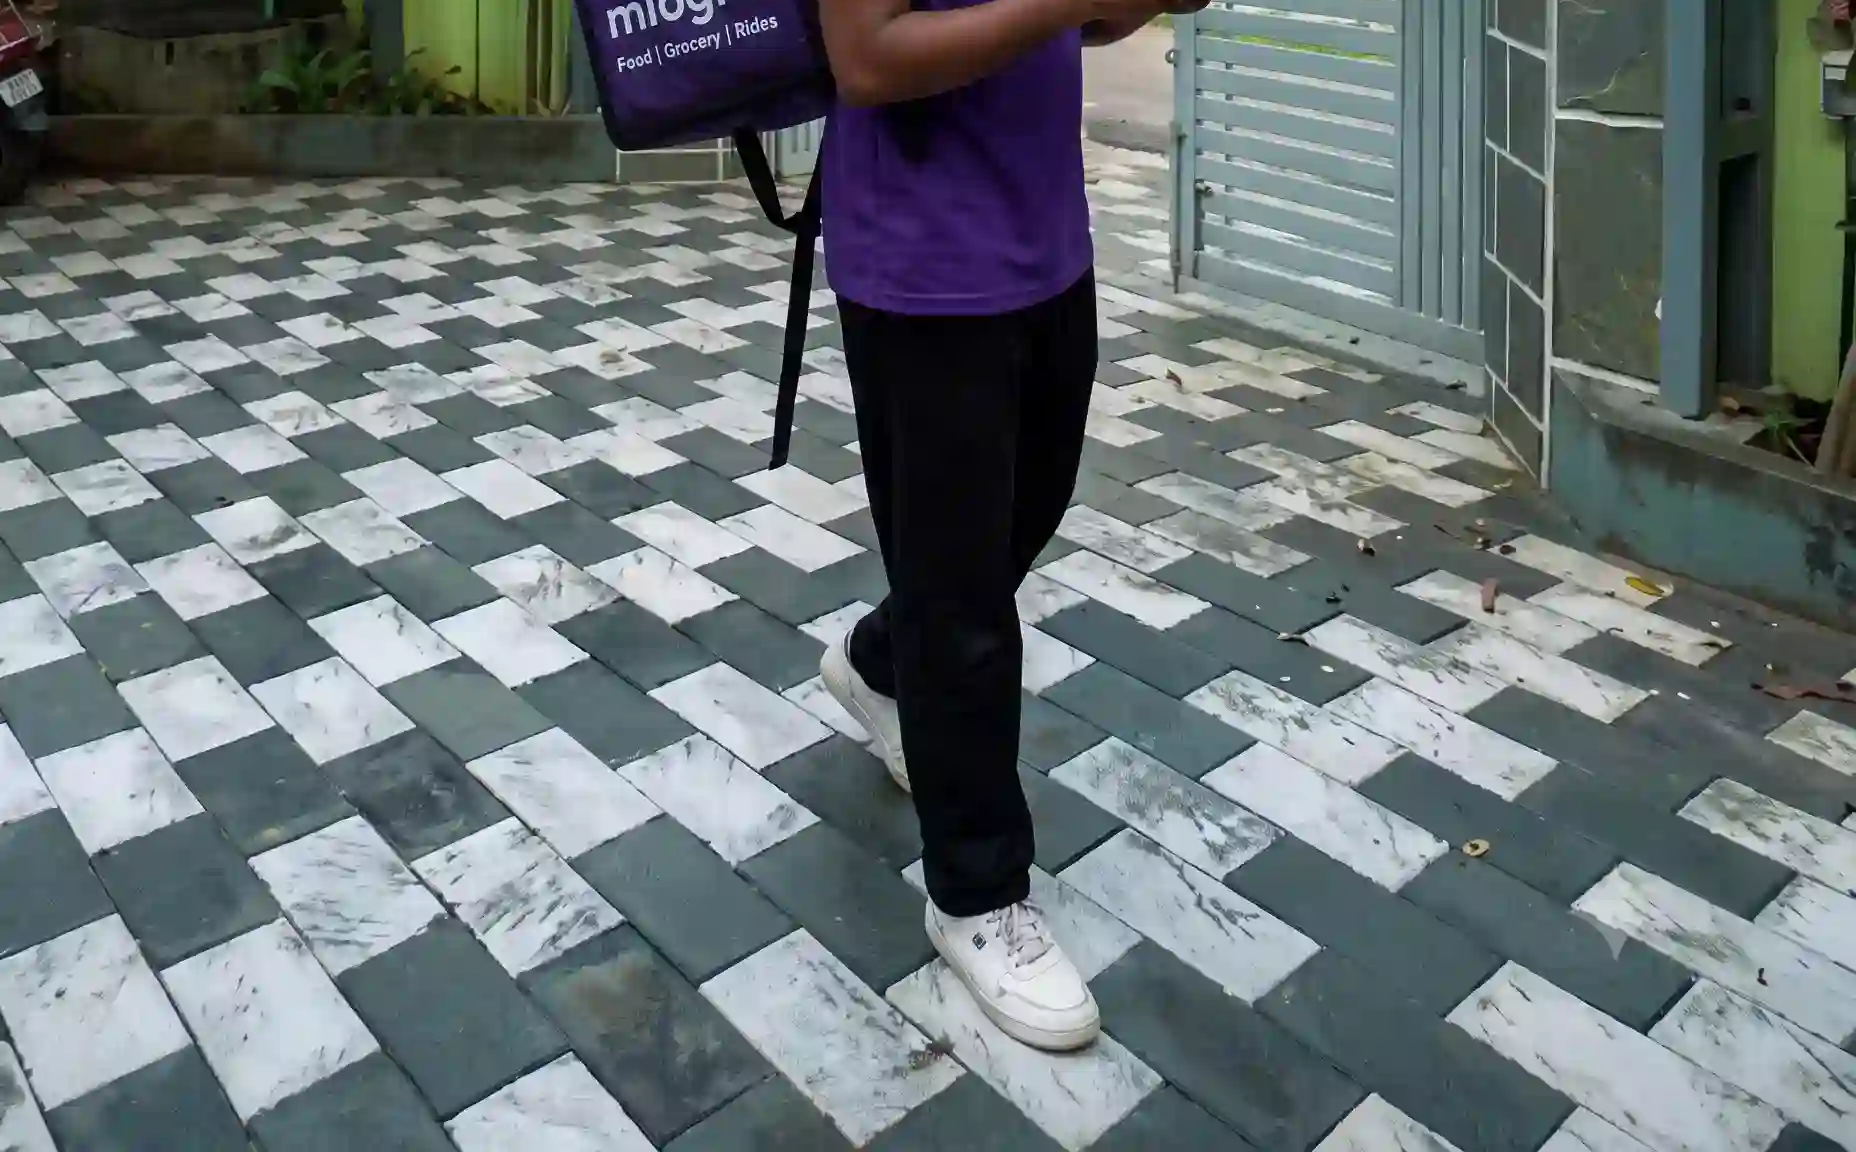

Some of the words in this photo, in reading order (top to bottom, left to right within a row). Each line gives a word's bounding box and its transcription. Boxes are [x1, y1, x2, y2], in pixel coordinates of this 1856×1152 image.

[617, 48, 653, 73] Food
[663, 32, 721, 58] Grocery
[734, 14, 779, 39] Rides
